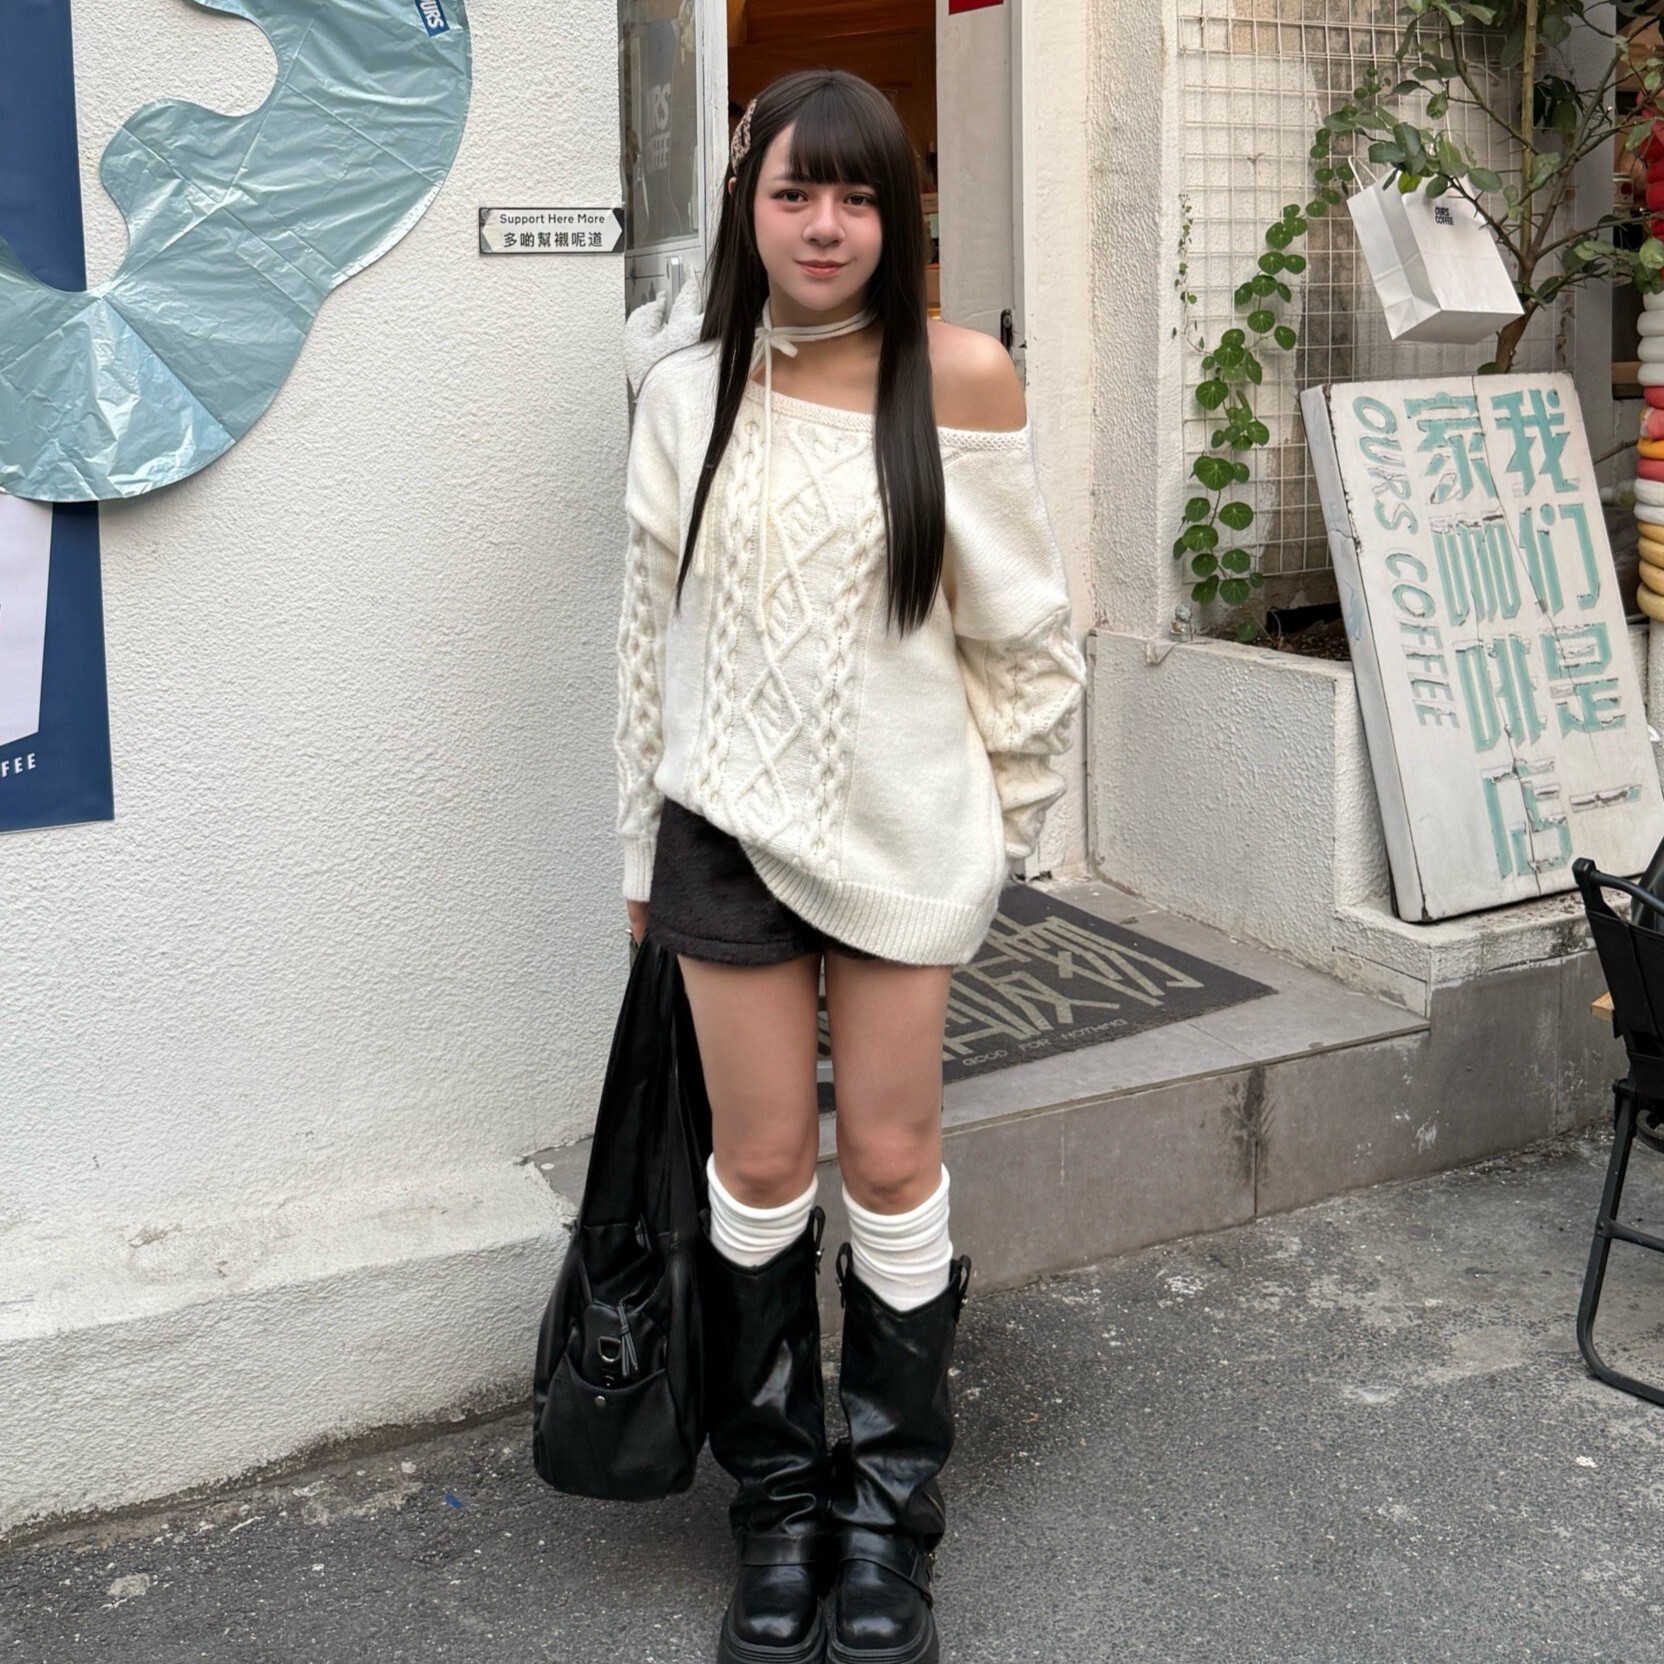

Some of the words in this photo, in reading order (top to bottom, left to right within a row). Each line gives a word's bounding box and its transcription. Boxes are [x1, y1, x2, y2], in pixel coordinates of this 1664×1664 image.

[420, 0, 445, 29] URS
[500, 214, 545, 225] Support
[548, 214, 574, 224] Here
[577, 214, 605, 224] More
[1352, 395, 1419, 535] OURS
[1385, 552, 1460, 729] COFFEE
[963, 1049, 1008, 1066] GOOD
[1018, 1037, 1051, 1053] FOR
[1061, 1018, 1128, 1041] NOTHING
